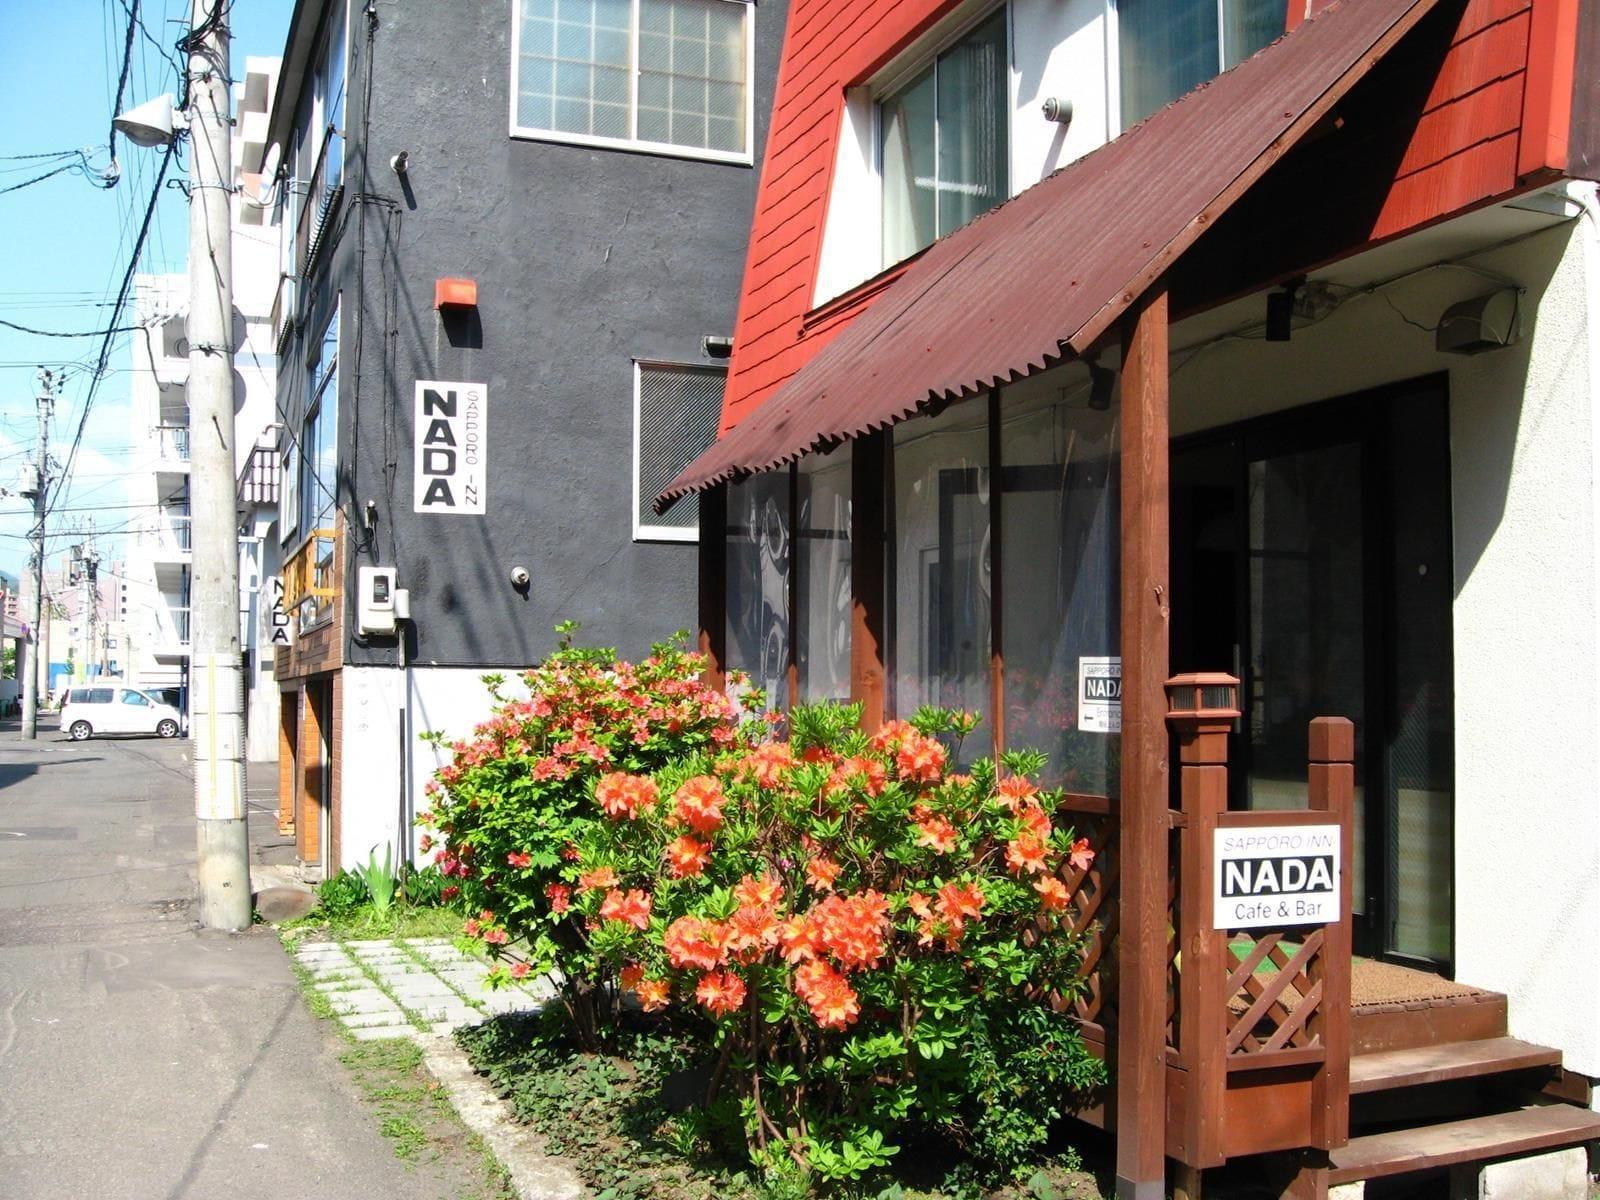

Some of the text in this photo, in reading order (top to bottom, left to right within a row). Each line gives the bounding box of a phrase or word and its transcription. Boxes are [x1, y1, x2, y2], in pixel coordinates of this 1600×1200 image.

[422, 388, 457, 506] NADA
[465, 390, 479, 506] SAPPORO INN
[1223, 834, 1334, 852] SAPPORO INN
[1225, 857, 1334, 895] NADA
[1235, 900, 1322, 920] Cafe & Bar
